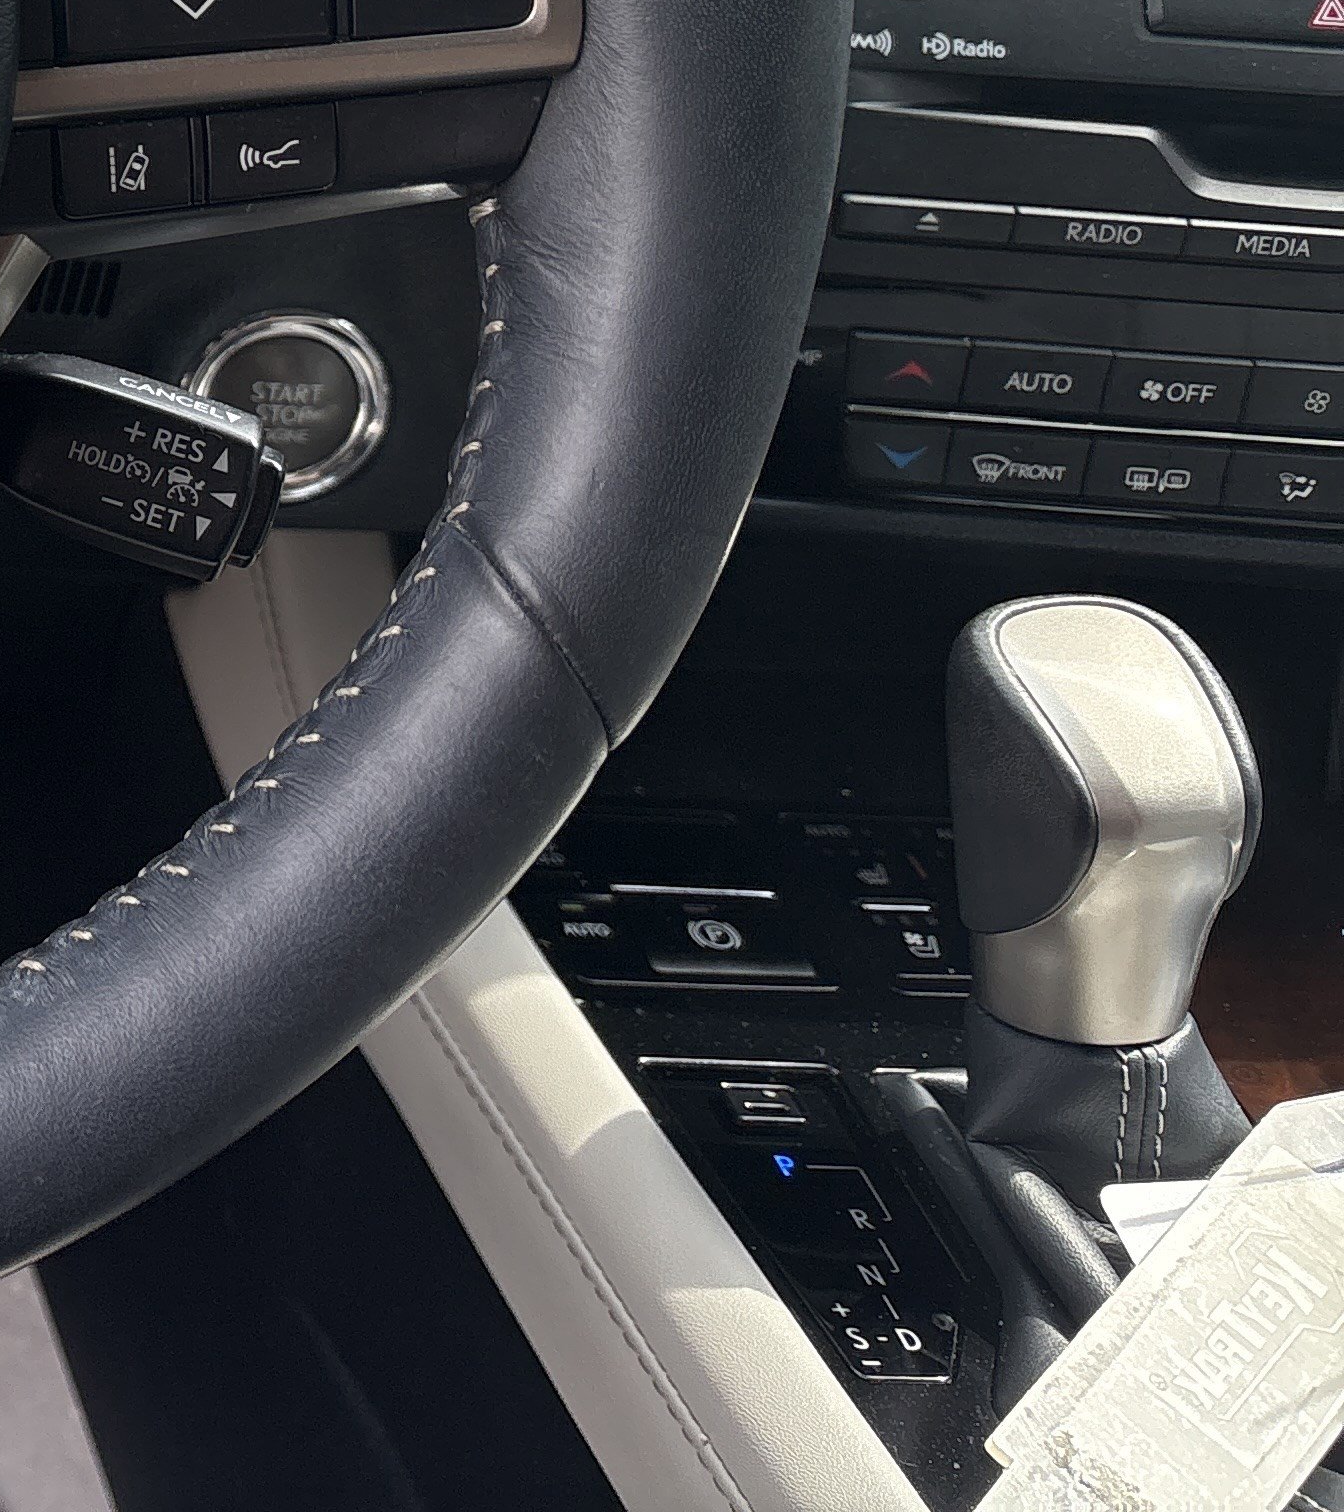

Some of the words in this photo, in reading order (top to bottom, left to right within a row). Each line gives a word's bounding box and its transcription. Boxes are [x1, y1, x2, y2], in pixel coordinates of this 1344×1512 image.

[952, 36, 1006, 59] Radio
[1066, 221, 1143, 246] RADIO
[1235, 234, 1311, 258] MEDIA
[250, 380, 325, 405] START
[1004, 370, 1074, 395] AUTO
[1166, 381, 1218, 405] OFF
[118, 376, 224, 420] CANCEL
[67, 440, 126, 474] HOLD
[151, 427, 207, 464] RES
[1007, 462, 1067, 483] FRONT
[129, 498, 185, 533] SET
[772, 1154, 795, 1177] P
[847, 1207, 877, 1231] R
[856, 1263, 887, 1287] N
[845, 1326, 870, 1351] S
[893, 1327, 922, 1352] D
